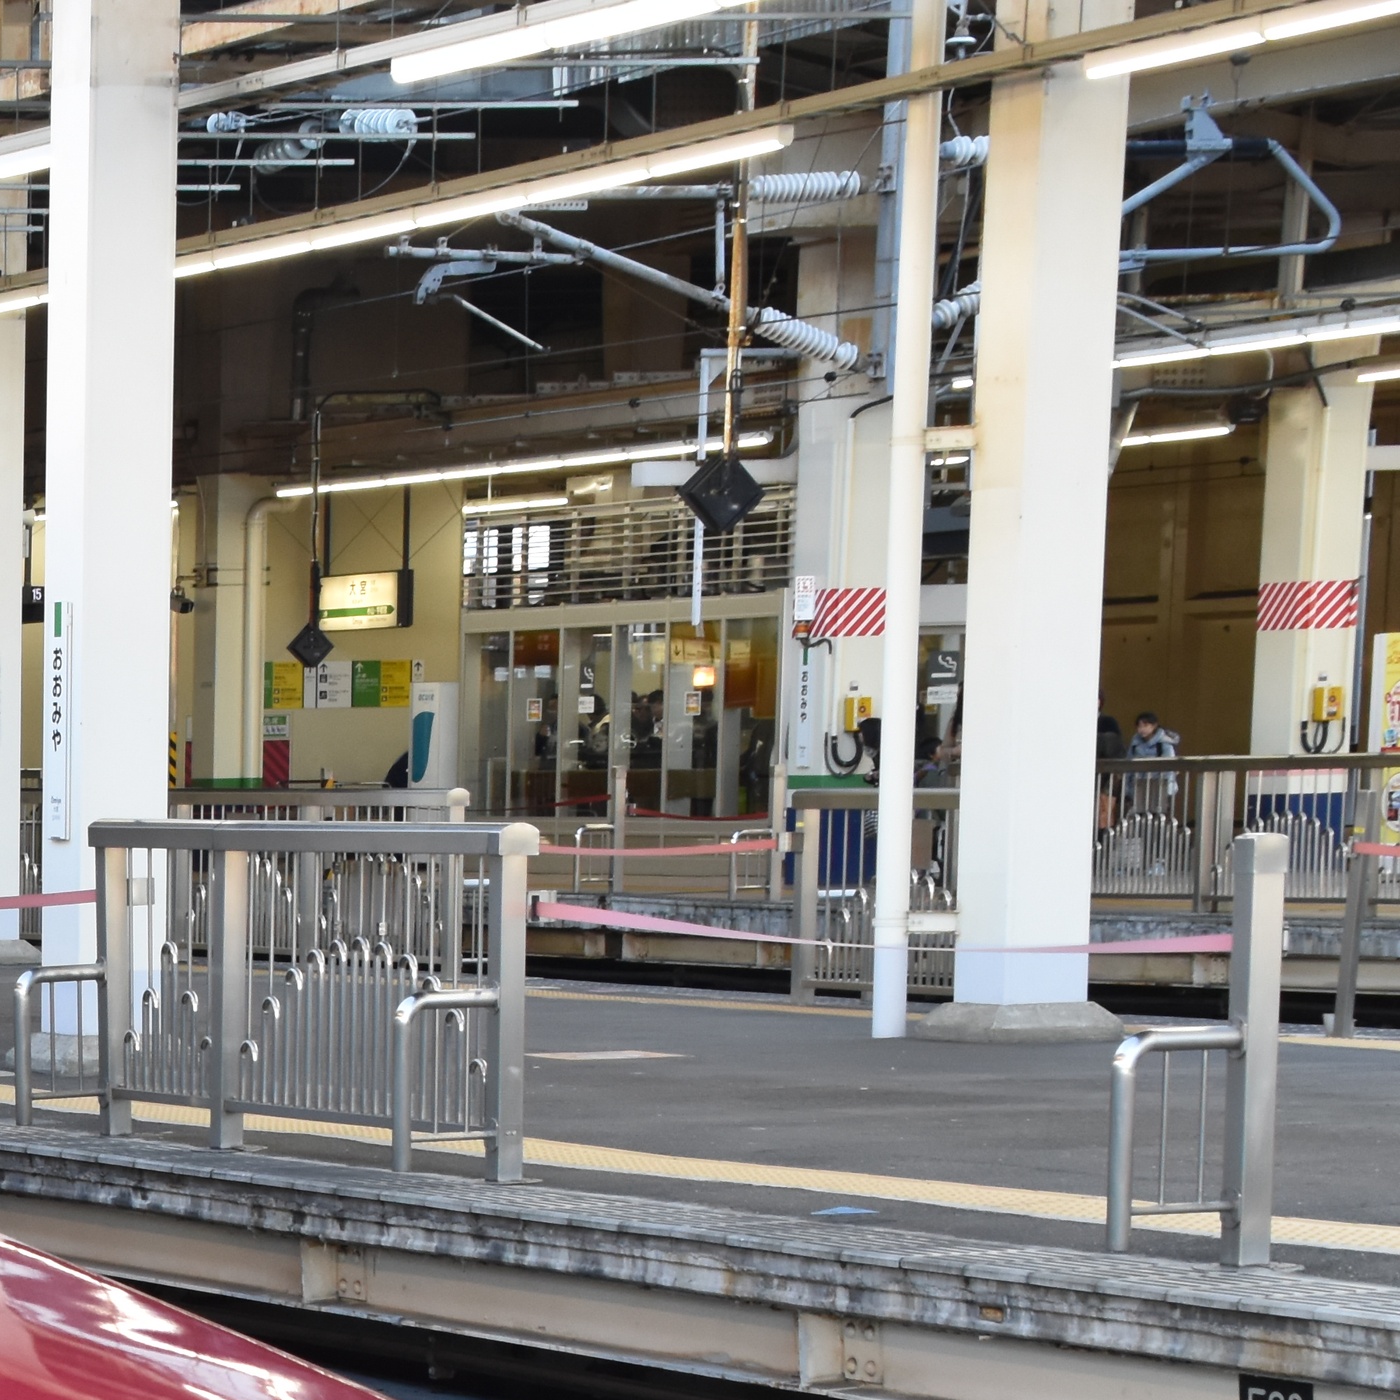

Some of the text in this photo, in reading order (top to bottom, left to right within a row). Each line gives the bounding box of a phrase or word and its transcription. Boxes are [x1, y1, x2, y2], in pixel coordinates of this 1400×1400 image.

[32, 588, 42, 601] 15
[52, 647, 63, 752] おおみや
